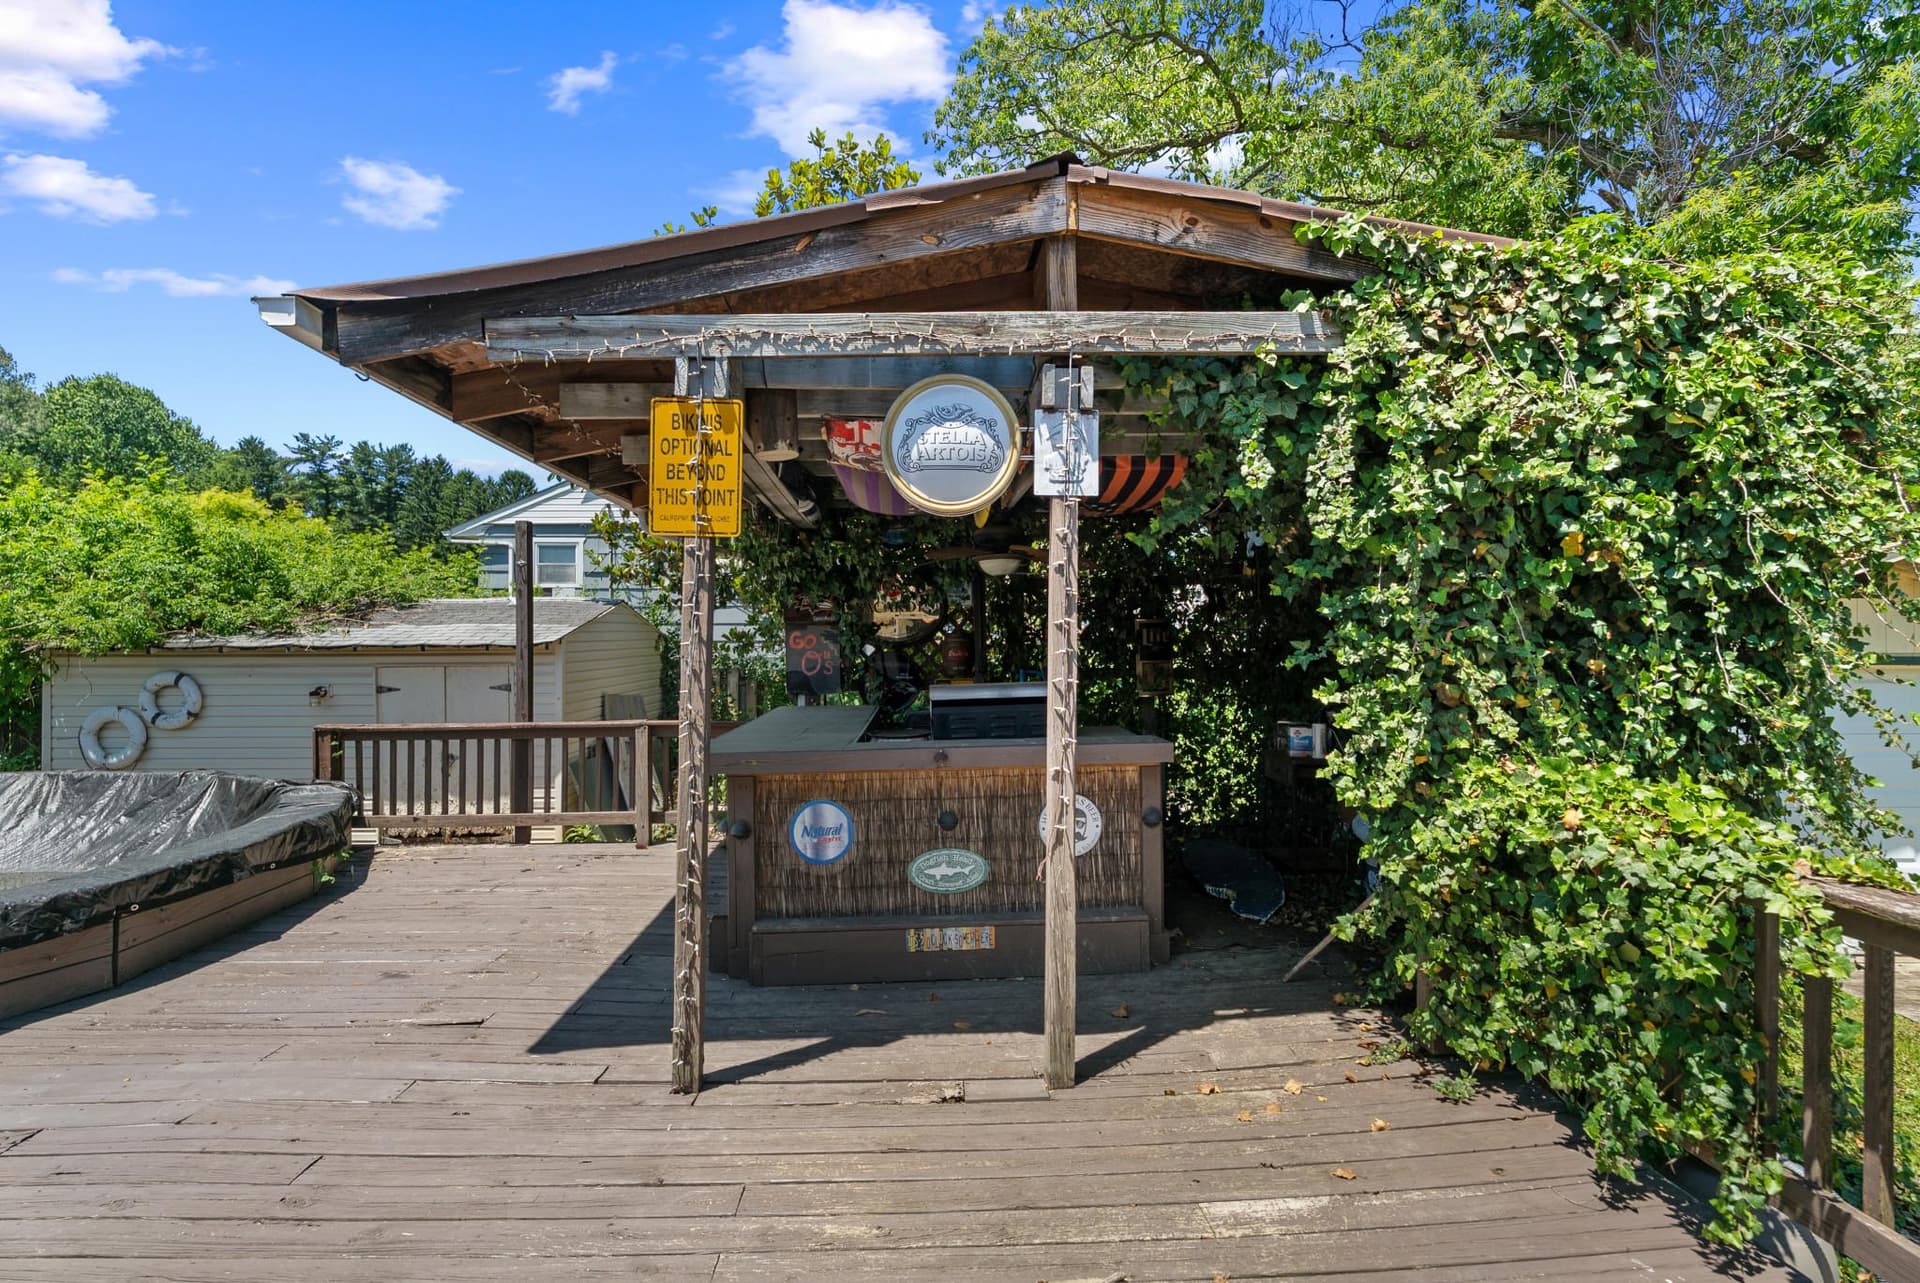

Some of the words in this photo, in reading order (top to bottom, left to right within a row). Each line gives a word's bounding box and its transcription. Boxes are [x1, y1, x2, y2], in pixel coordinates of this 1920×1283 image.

[671, 413, 722, 431] BIKINIS
[918, 430, 987, 445] STELLA
[660, 438, 732, 457] OPTIONAL
[916, 447, 986, 461] ARTOIS
[666, 463, 726, 481] BEYOND
[656, 488, 687, 505] THIS
[789, 630, 817, 649] GO
[801, 822, 844, 838] Natural
